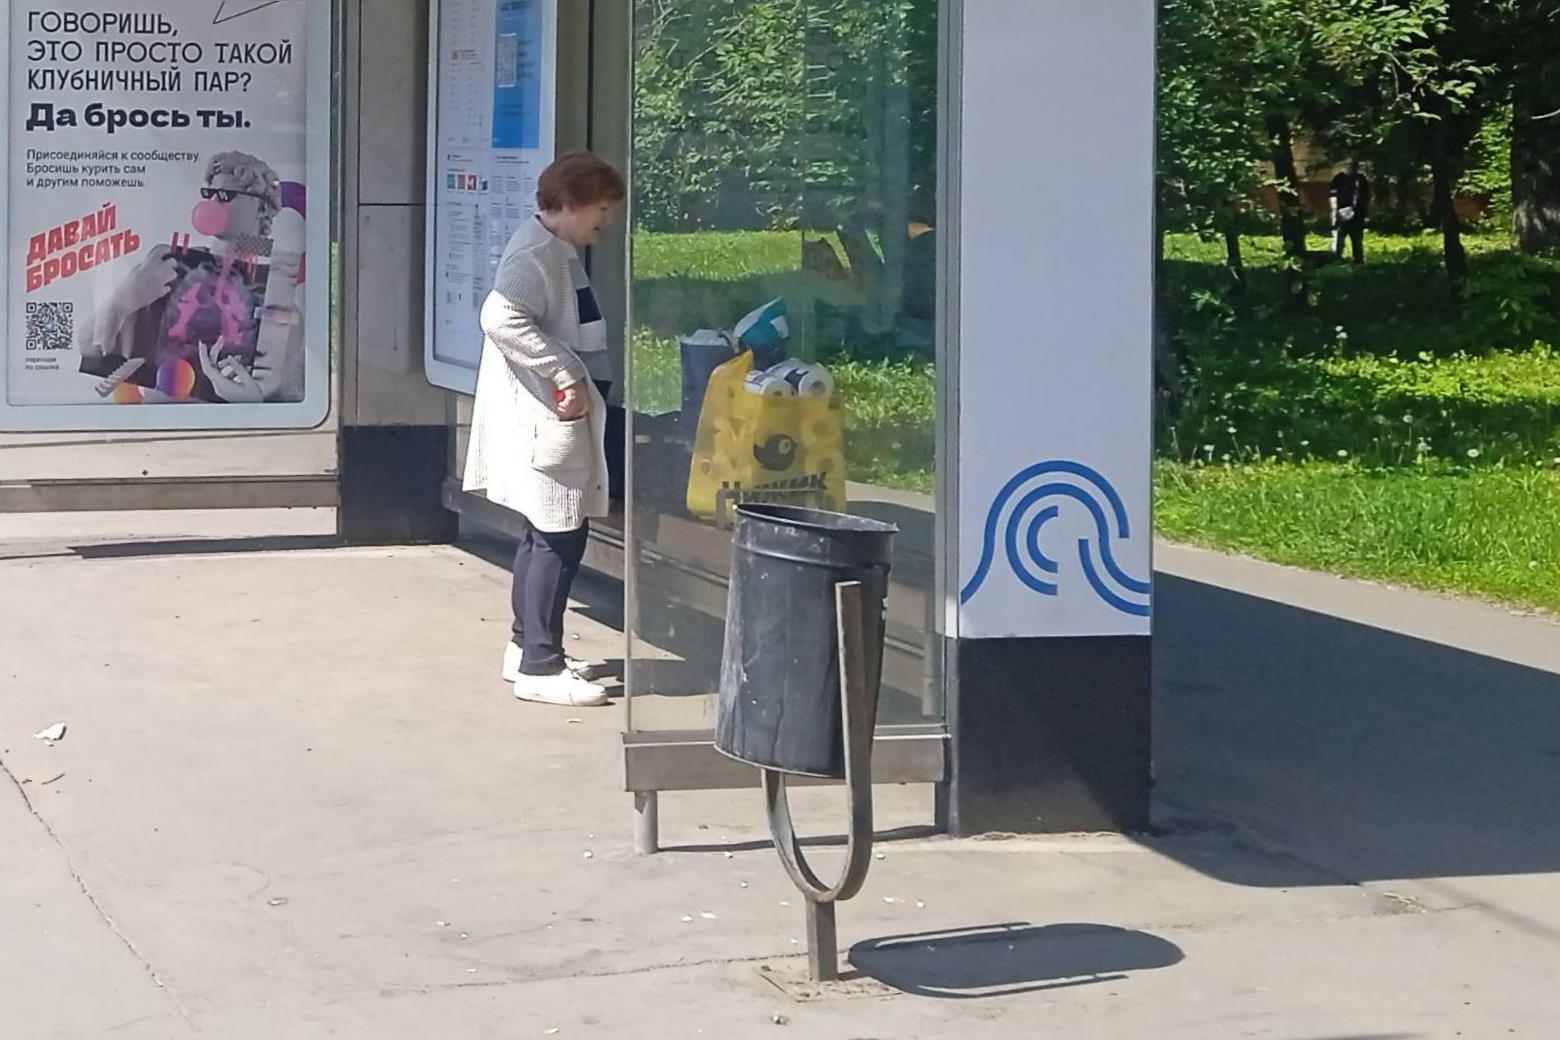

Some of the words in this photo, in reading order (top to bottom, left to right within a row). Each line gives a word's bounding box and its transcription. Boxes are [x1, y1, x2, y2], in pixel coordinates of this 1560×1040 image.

[27, 10, 179, 37] ГОВОРИШЬ,
[27, 40, 83, 62] ЭТО
[95, 41, 203, 64] ПРОСТО
[214, 38, 292, 65] ТАКОЙ
[194, 71, 253, 92] ПАР?
[25, 103, 78, 132] Да
[83, 103, 191, 134] брось
[195, 109, 252, 129] ты.
[26, 149, 118, 162] Присоединяйся
[121, 152, 129, 160] к
[26, 162, 80, 176] Бросишь
[81, 165, 122, 177] курить
[123, 166, 146, 174] сам
[26, 178, 35, 186] и
[36, 178, 79, 190] другим
[26, 201, 117, 267] ДАВАЙ
[26, 228, 140, 293] БРОСАТЬ
